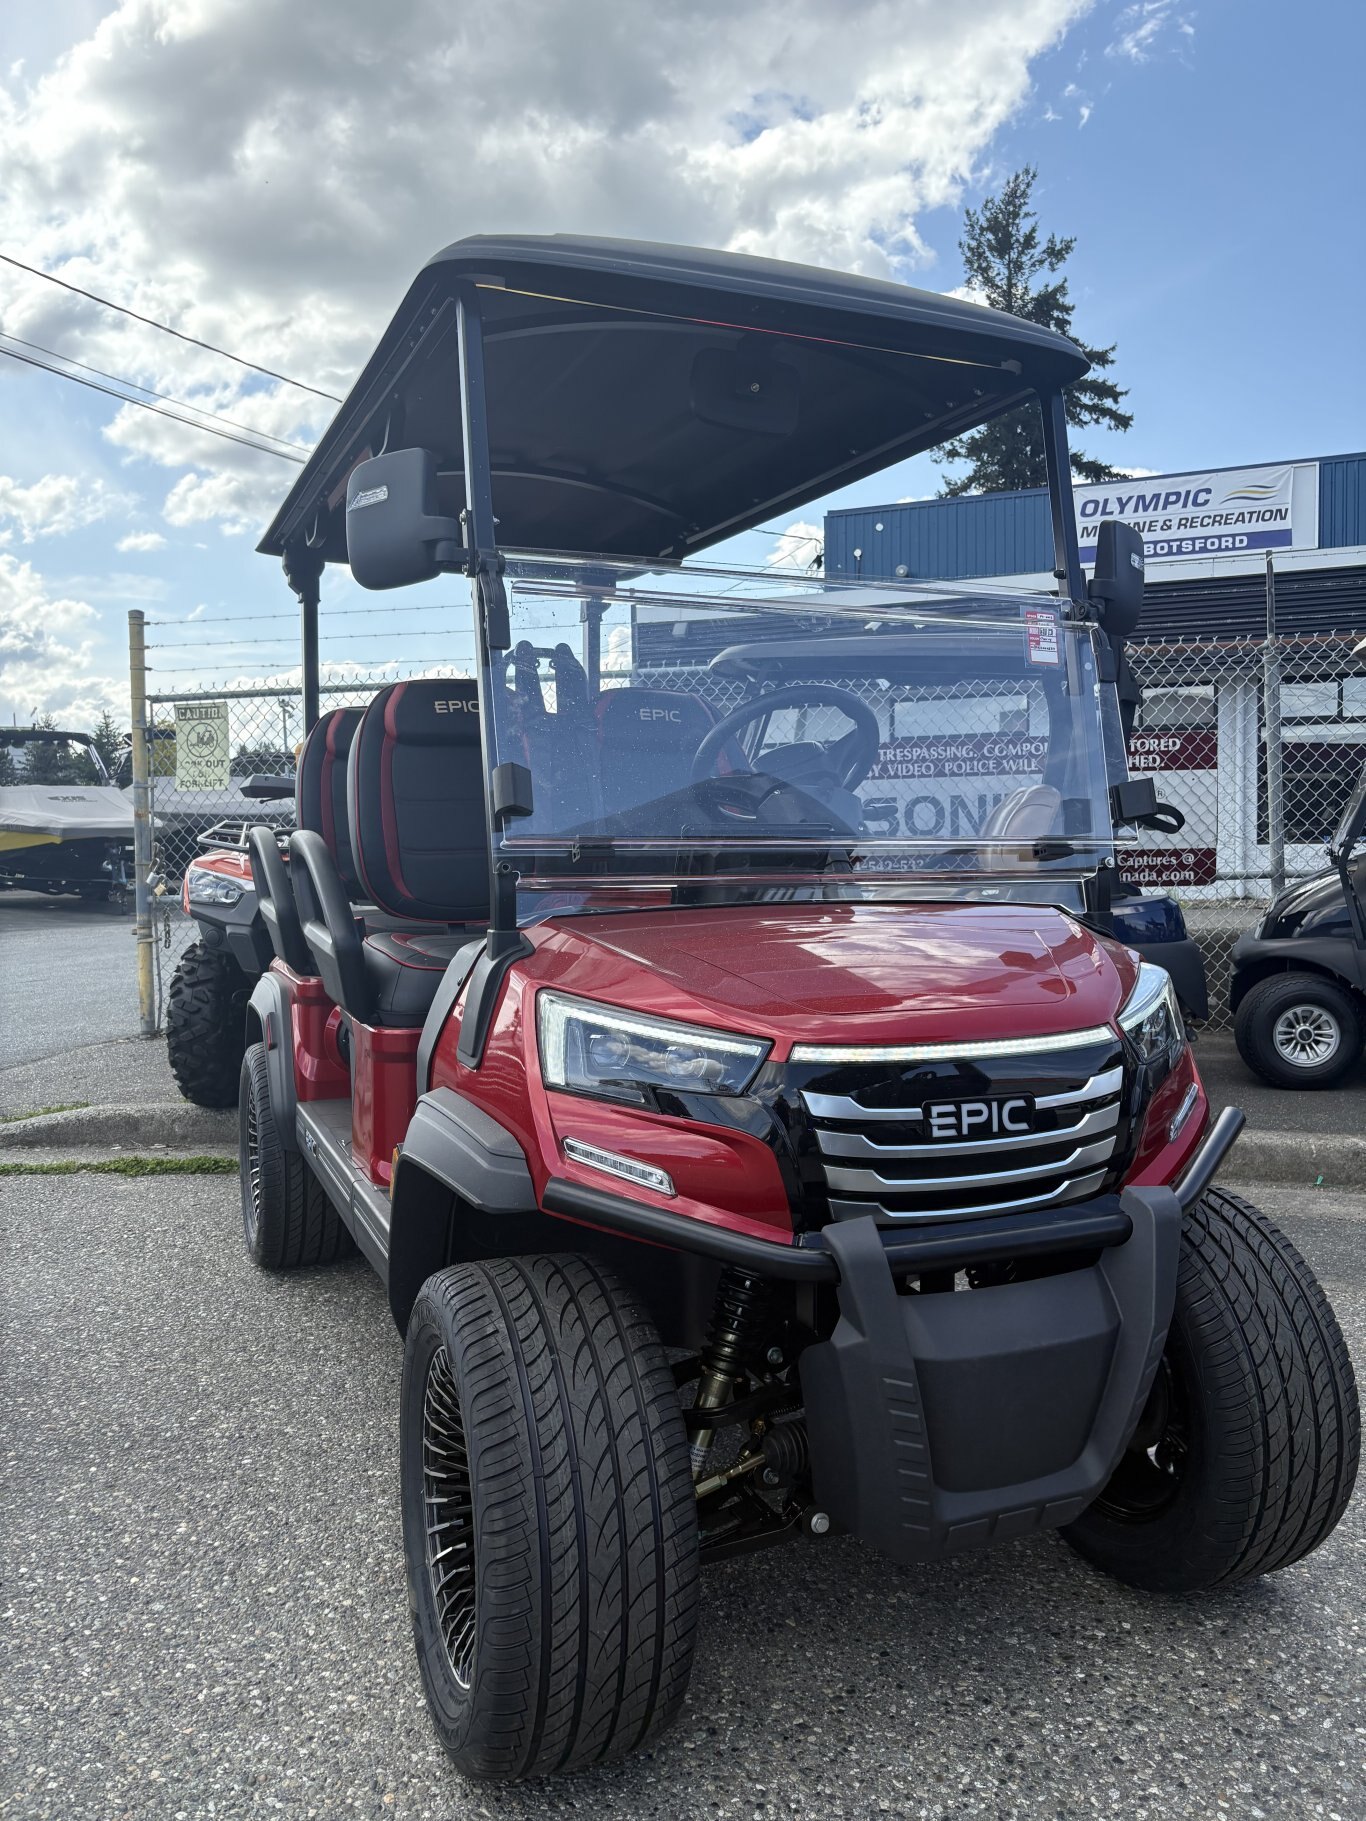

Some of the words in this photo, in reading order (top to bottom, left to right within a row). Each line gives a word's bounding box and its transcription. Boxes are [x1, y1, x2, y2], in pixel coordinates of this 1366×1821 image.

[1080, 488, 1212, 518] OLYMPIC
[1080, 520, 1159, 538] MNE
[1160, 519, 1173, 531] &
[1177, 508, 1289, 530] RECREATION
[178, 707, 222, 719] CAUTIO
[639, 708, 682, 723] EPIC
[878, 746, 978, 761] TRESPASSING.
[887, 762, 934, 776] VIDEO
[944, 760, 997, 774] POLICE
[1118, 854, 1177, 868] Captures
[1182, 853, 1195, 865] @
[929, 1100, 1029, 1137] EPIC
